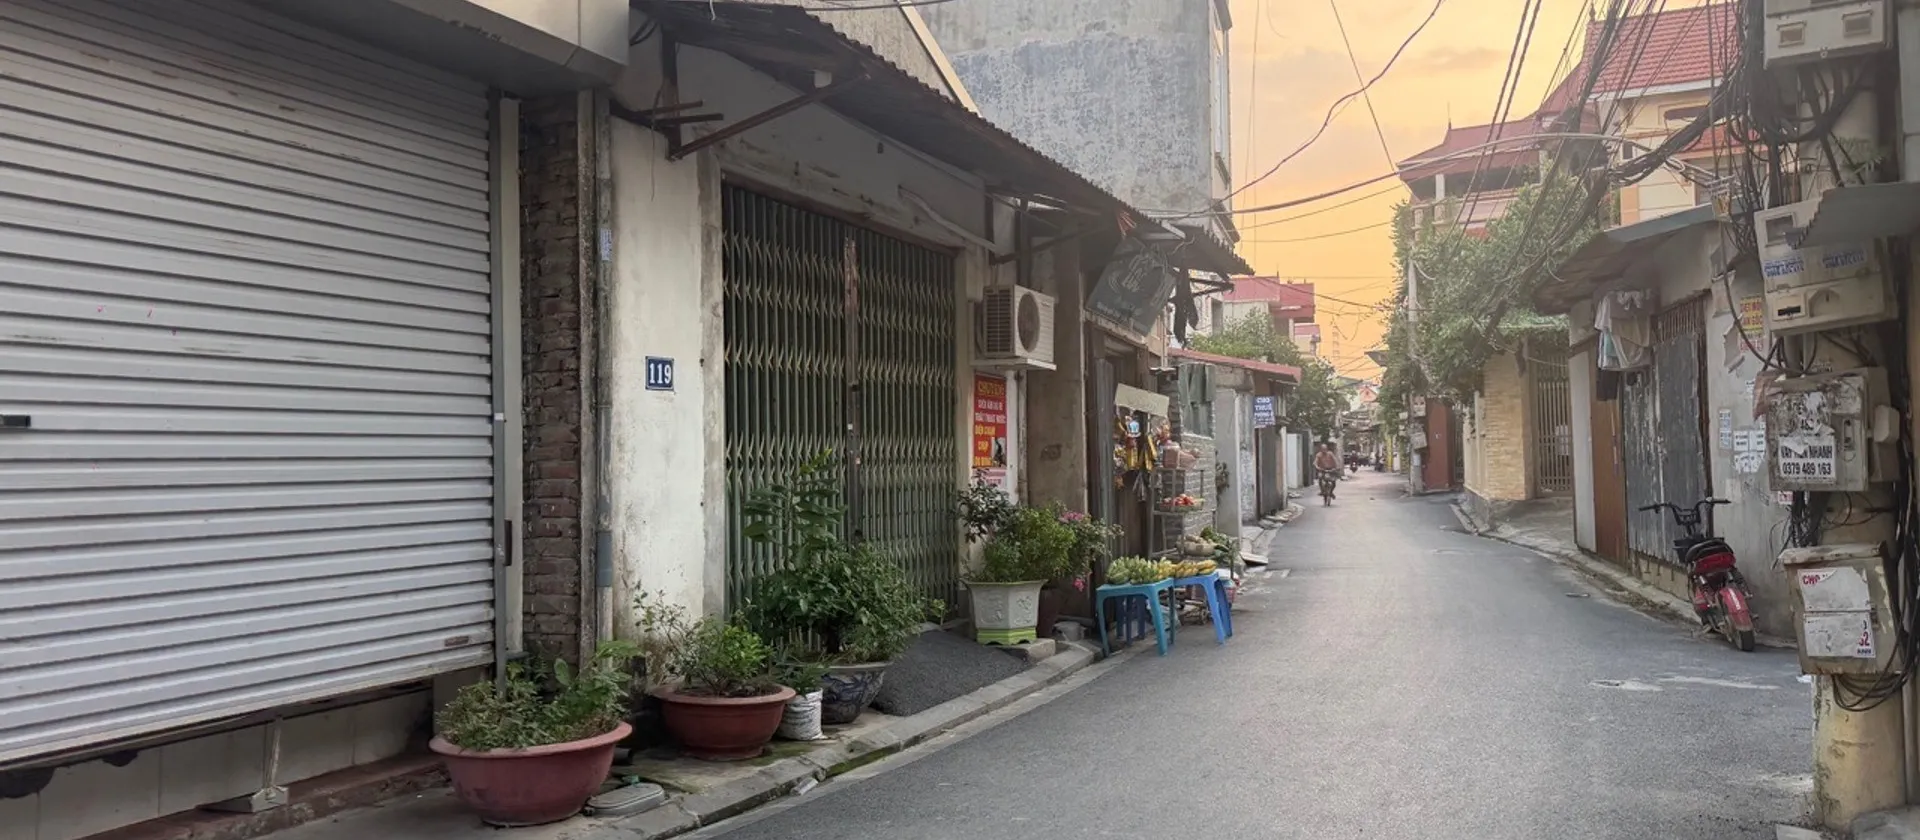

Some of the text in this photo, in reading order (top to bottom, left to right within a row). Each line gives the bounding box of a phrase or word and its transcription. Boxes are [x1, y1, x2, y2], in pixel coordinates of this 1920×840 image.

[649, 363, 672, 384] 119
[1809, 446, 1832, 459] NHANH
[1783, 462, 1831, 475] 0379 489 163
